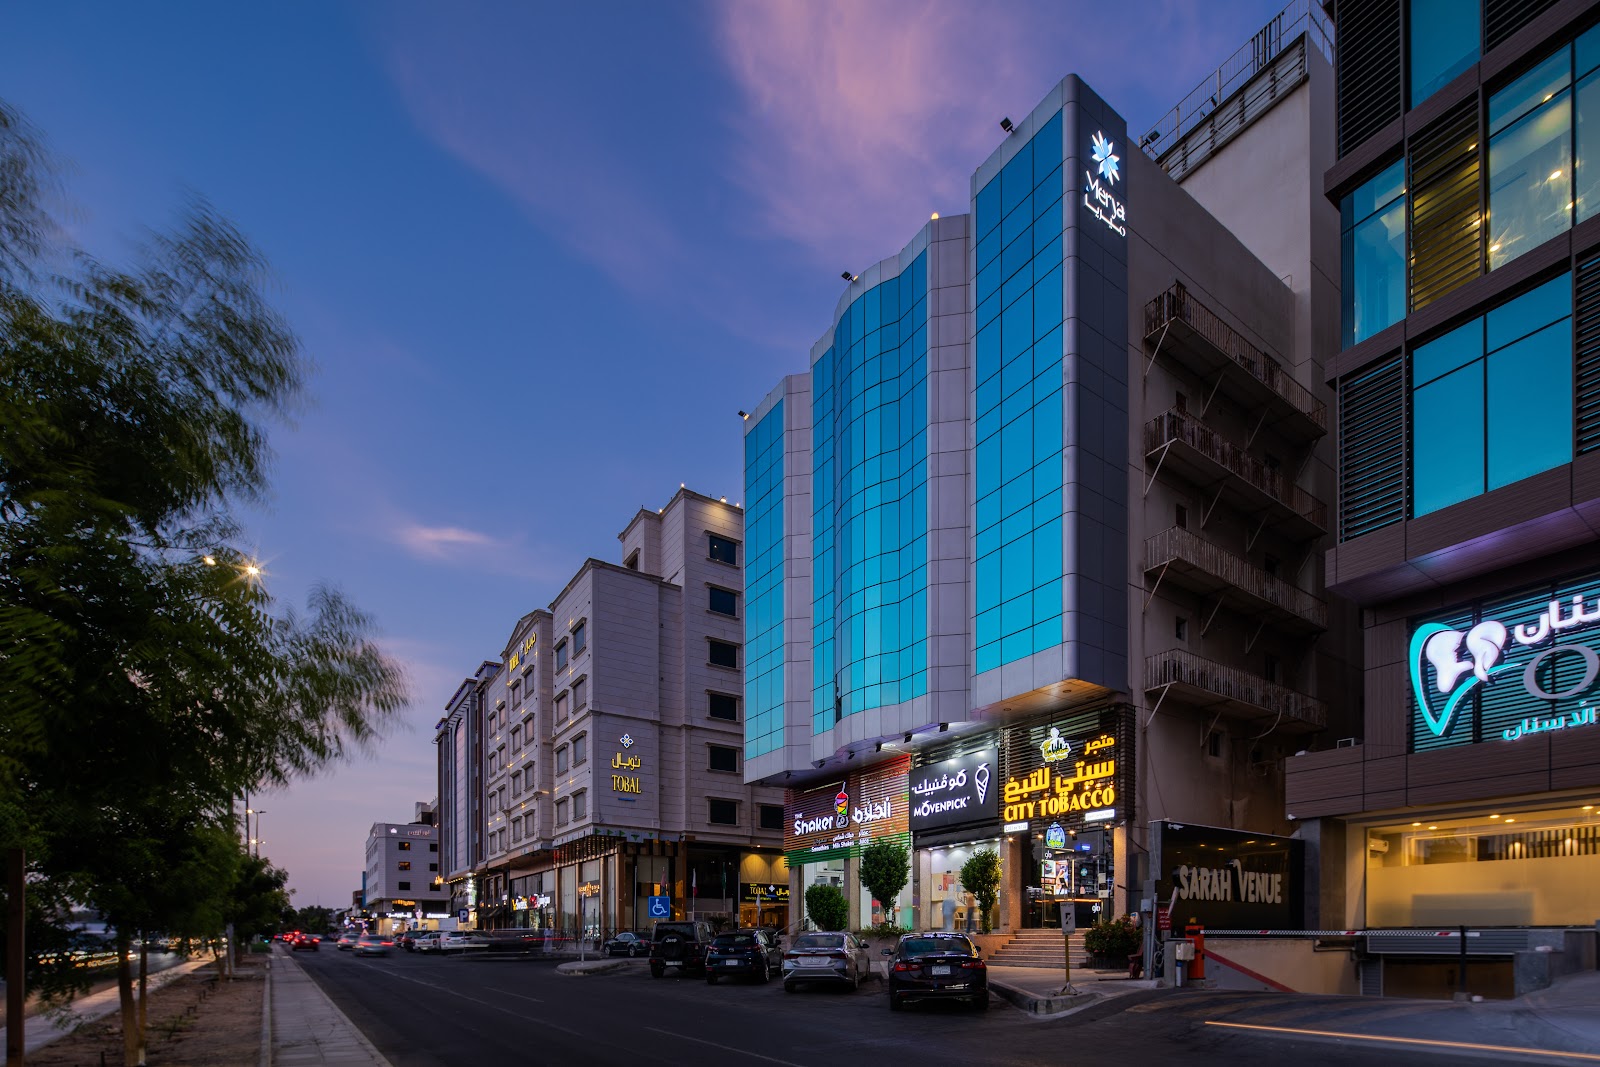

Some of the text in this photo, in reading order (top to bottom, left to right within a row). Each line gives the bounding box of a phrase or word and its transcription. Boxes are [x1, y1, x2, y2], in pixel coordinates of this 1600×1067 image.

[1084, 734, 1115, 756] متجر
[611, 752, 641, 771] توبال
[611, 774, 642, 794] TOBAL
[1003, 760, 1115, 803] سيتي للتبغ
[1003, 801, 1036, 822] CITY
[1039, 787, 1115, 817] TOBACCO
[794, 815, 834, 836] Shaker
[1179, 858, 1282, 904] SARAH VENUE
